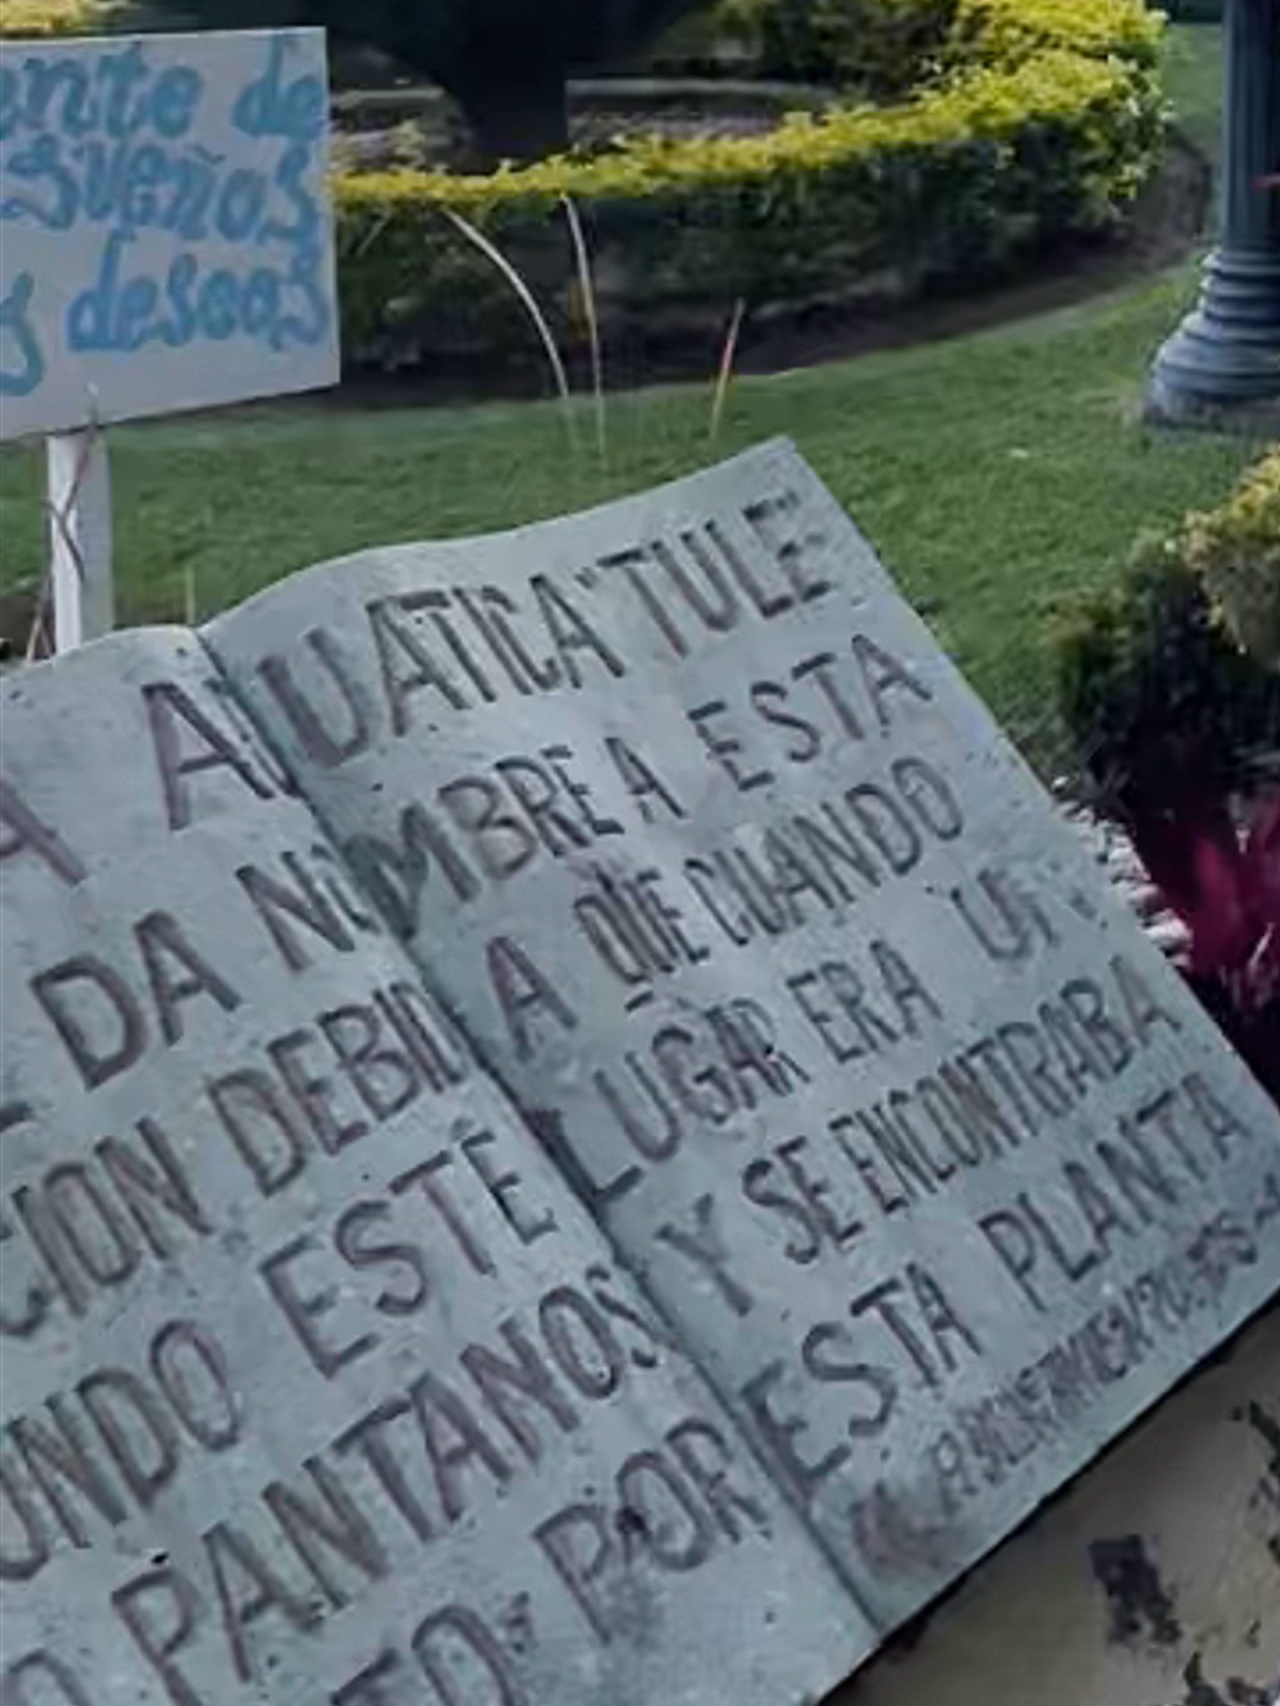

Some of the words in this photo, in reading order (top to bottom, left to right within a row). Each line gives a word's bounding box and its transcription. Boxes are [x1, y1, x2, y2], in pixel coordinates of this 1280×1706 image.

[605, 736, 686, 822] A
[687, 634, 935, 792] ESTA
[486, 935, 578, 1066] A
[684, 756, 964, 947] CUANDO
[258, 1128, 560, 1380] ESTE
[786, 939, 944, 1065] ERA
[656, 1193, 754, 1314] Y
[742, 1137, 865, 1265] SE
[828, 954, 1182, 1215] ENCONTRABA
[534, 1419, 770, 1644] POR
[742, 1263, 982, 1487] ESTA
[978, 1071, 1251, 1313] PLANTA
